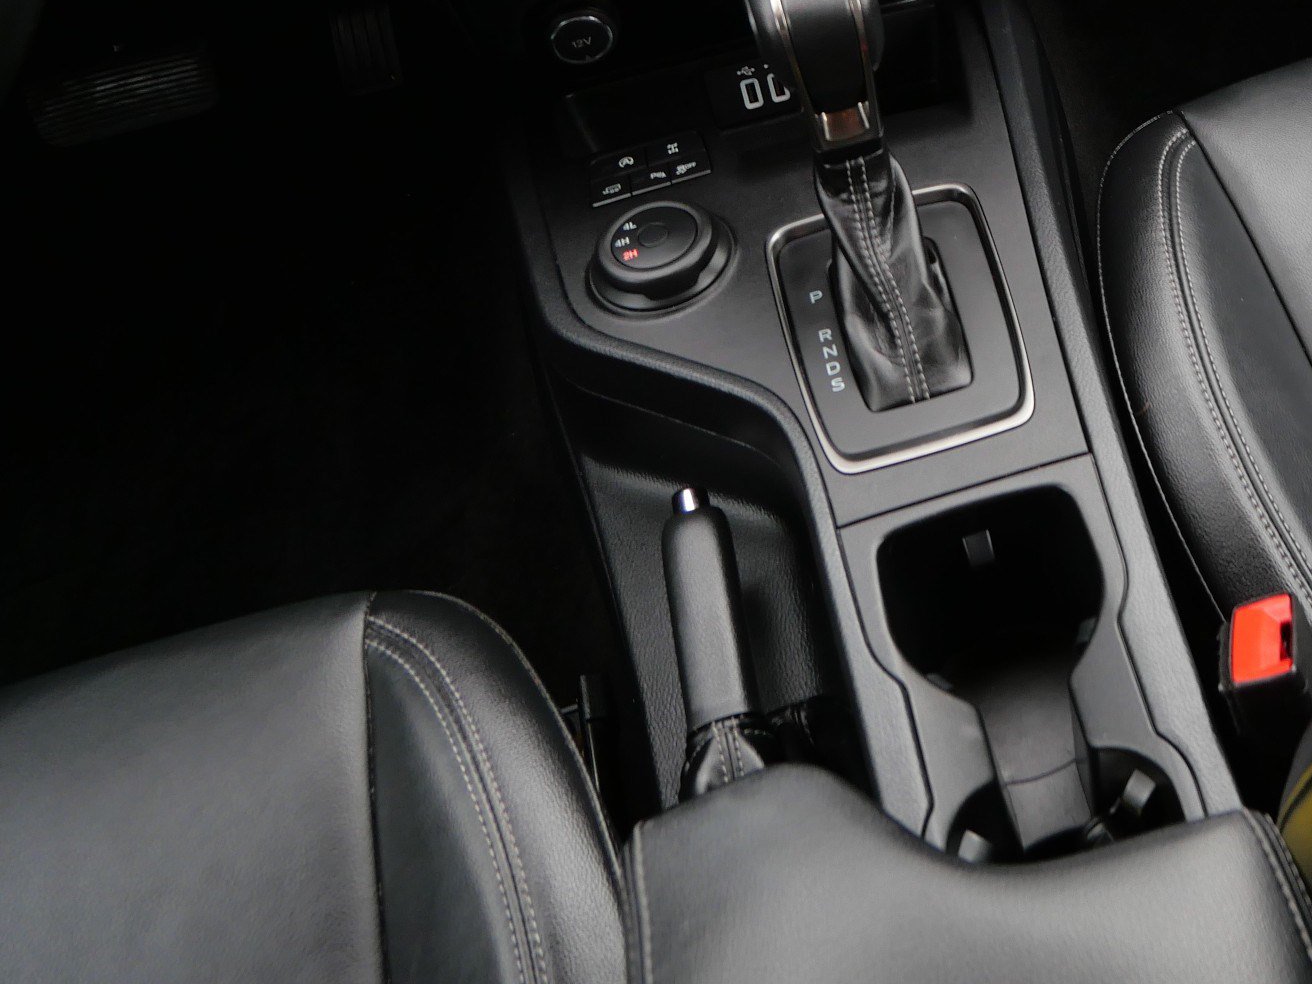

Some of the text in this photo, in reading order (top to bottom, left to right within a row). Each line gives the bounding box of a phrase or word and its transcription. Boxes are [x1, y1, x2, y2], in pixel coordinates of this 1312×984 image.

[571, 36, 592, 49] 12V
[622, 221, 637, 231] 4L
[614, 236, 630, 248] 4H
[621, 248, 639, 261] 2H
[809, 289, 823, 304] P
[818, 328, 832, 342] R
[822, 345, 838, 359] N
[825, 361, 841, 376] D
[831, 377, 845, 392] S
